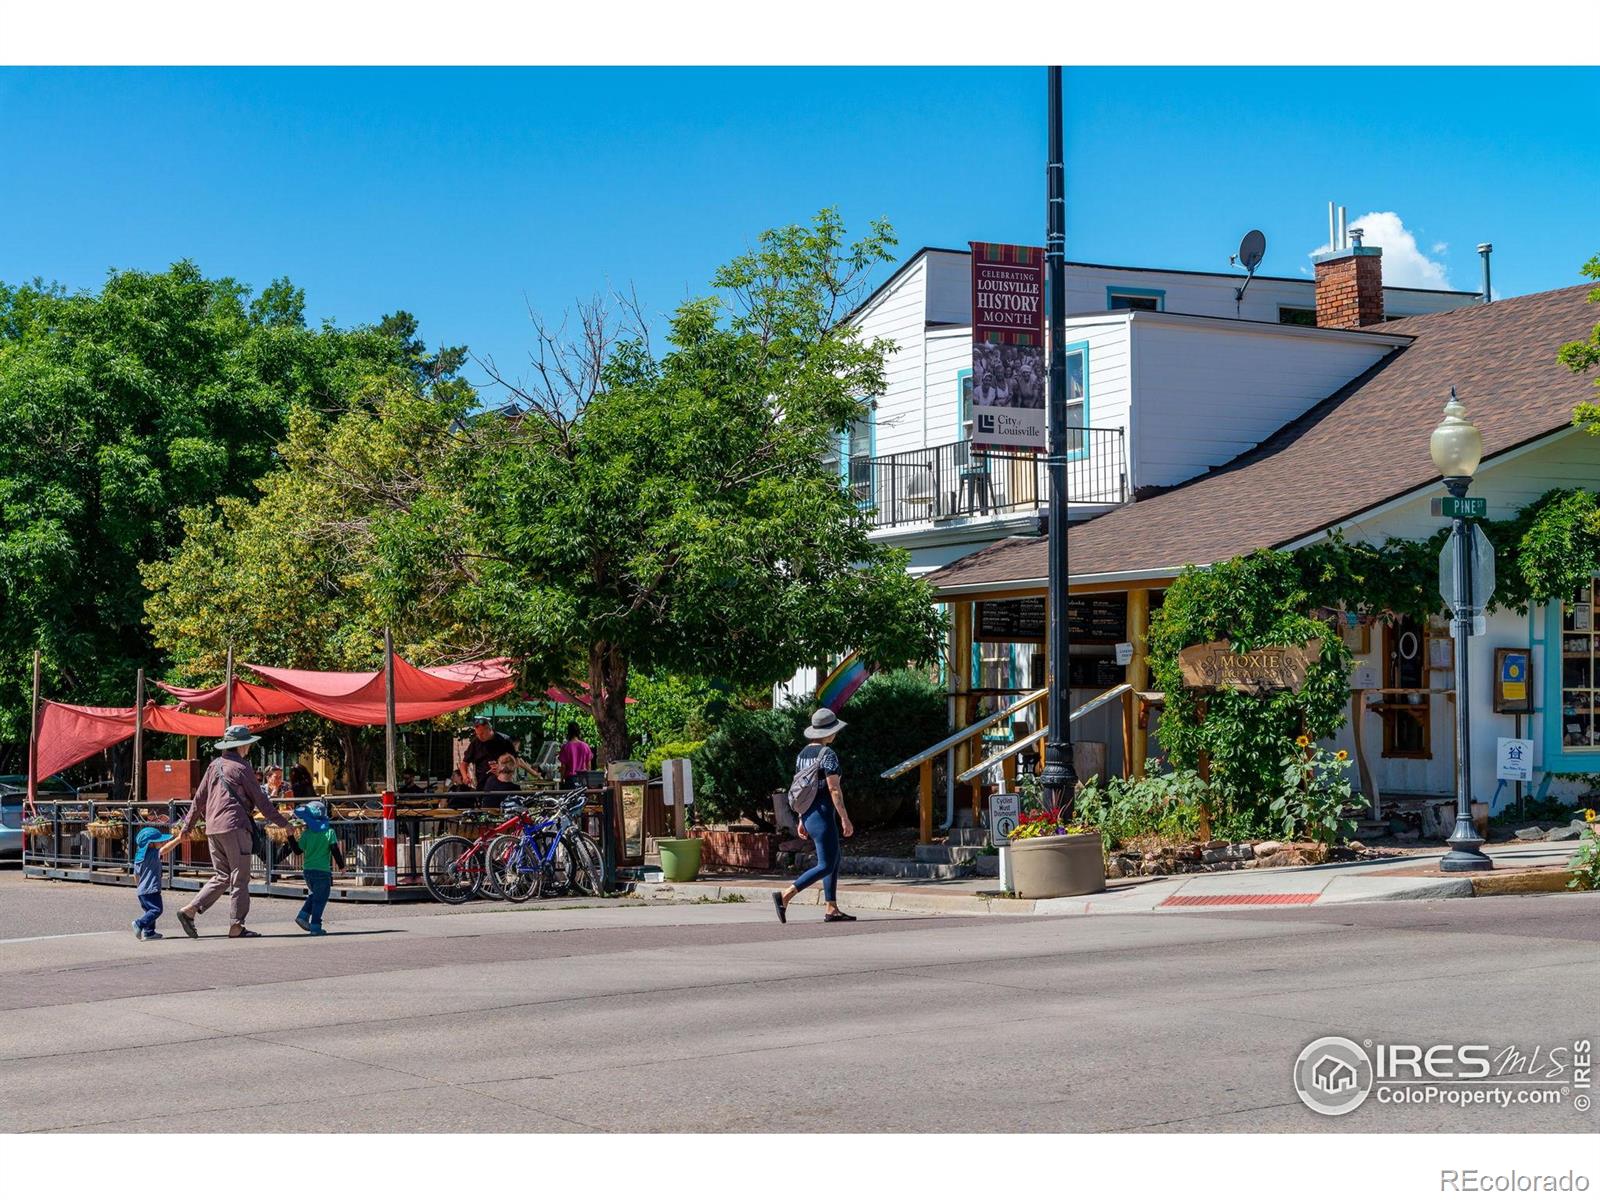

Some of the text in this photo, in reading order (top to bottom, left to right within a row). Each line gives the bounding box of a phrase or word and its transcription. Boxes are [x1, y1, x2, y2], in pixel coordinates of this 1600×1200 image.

[982, 270, 1034, 281] CELEBRATING
[977, 279, 1039, 294] LOUISVILLE
[977, 292, 1039, 312] HISTORY
[984, 311, 1032, 324] MONTH
[998, 414, 1017, 426] City
[998, 424, 1040, 436] Louisville
[1454, 500, 1476, 513] PINE
[1221, 655, 1280, 669] MOXIE
